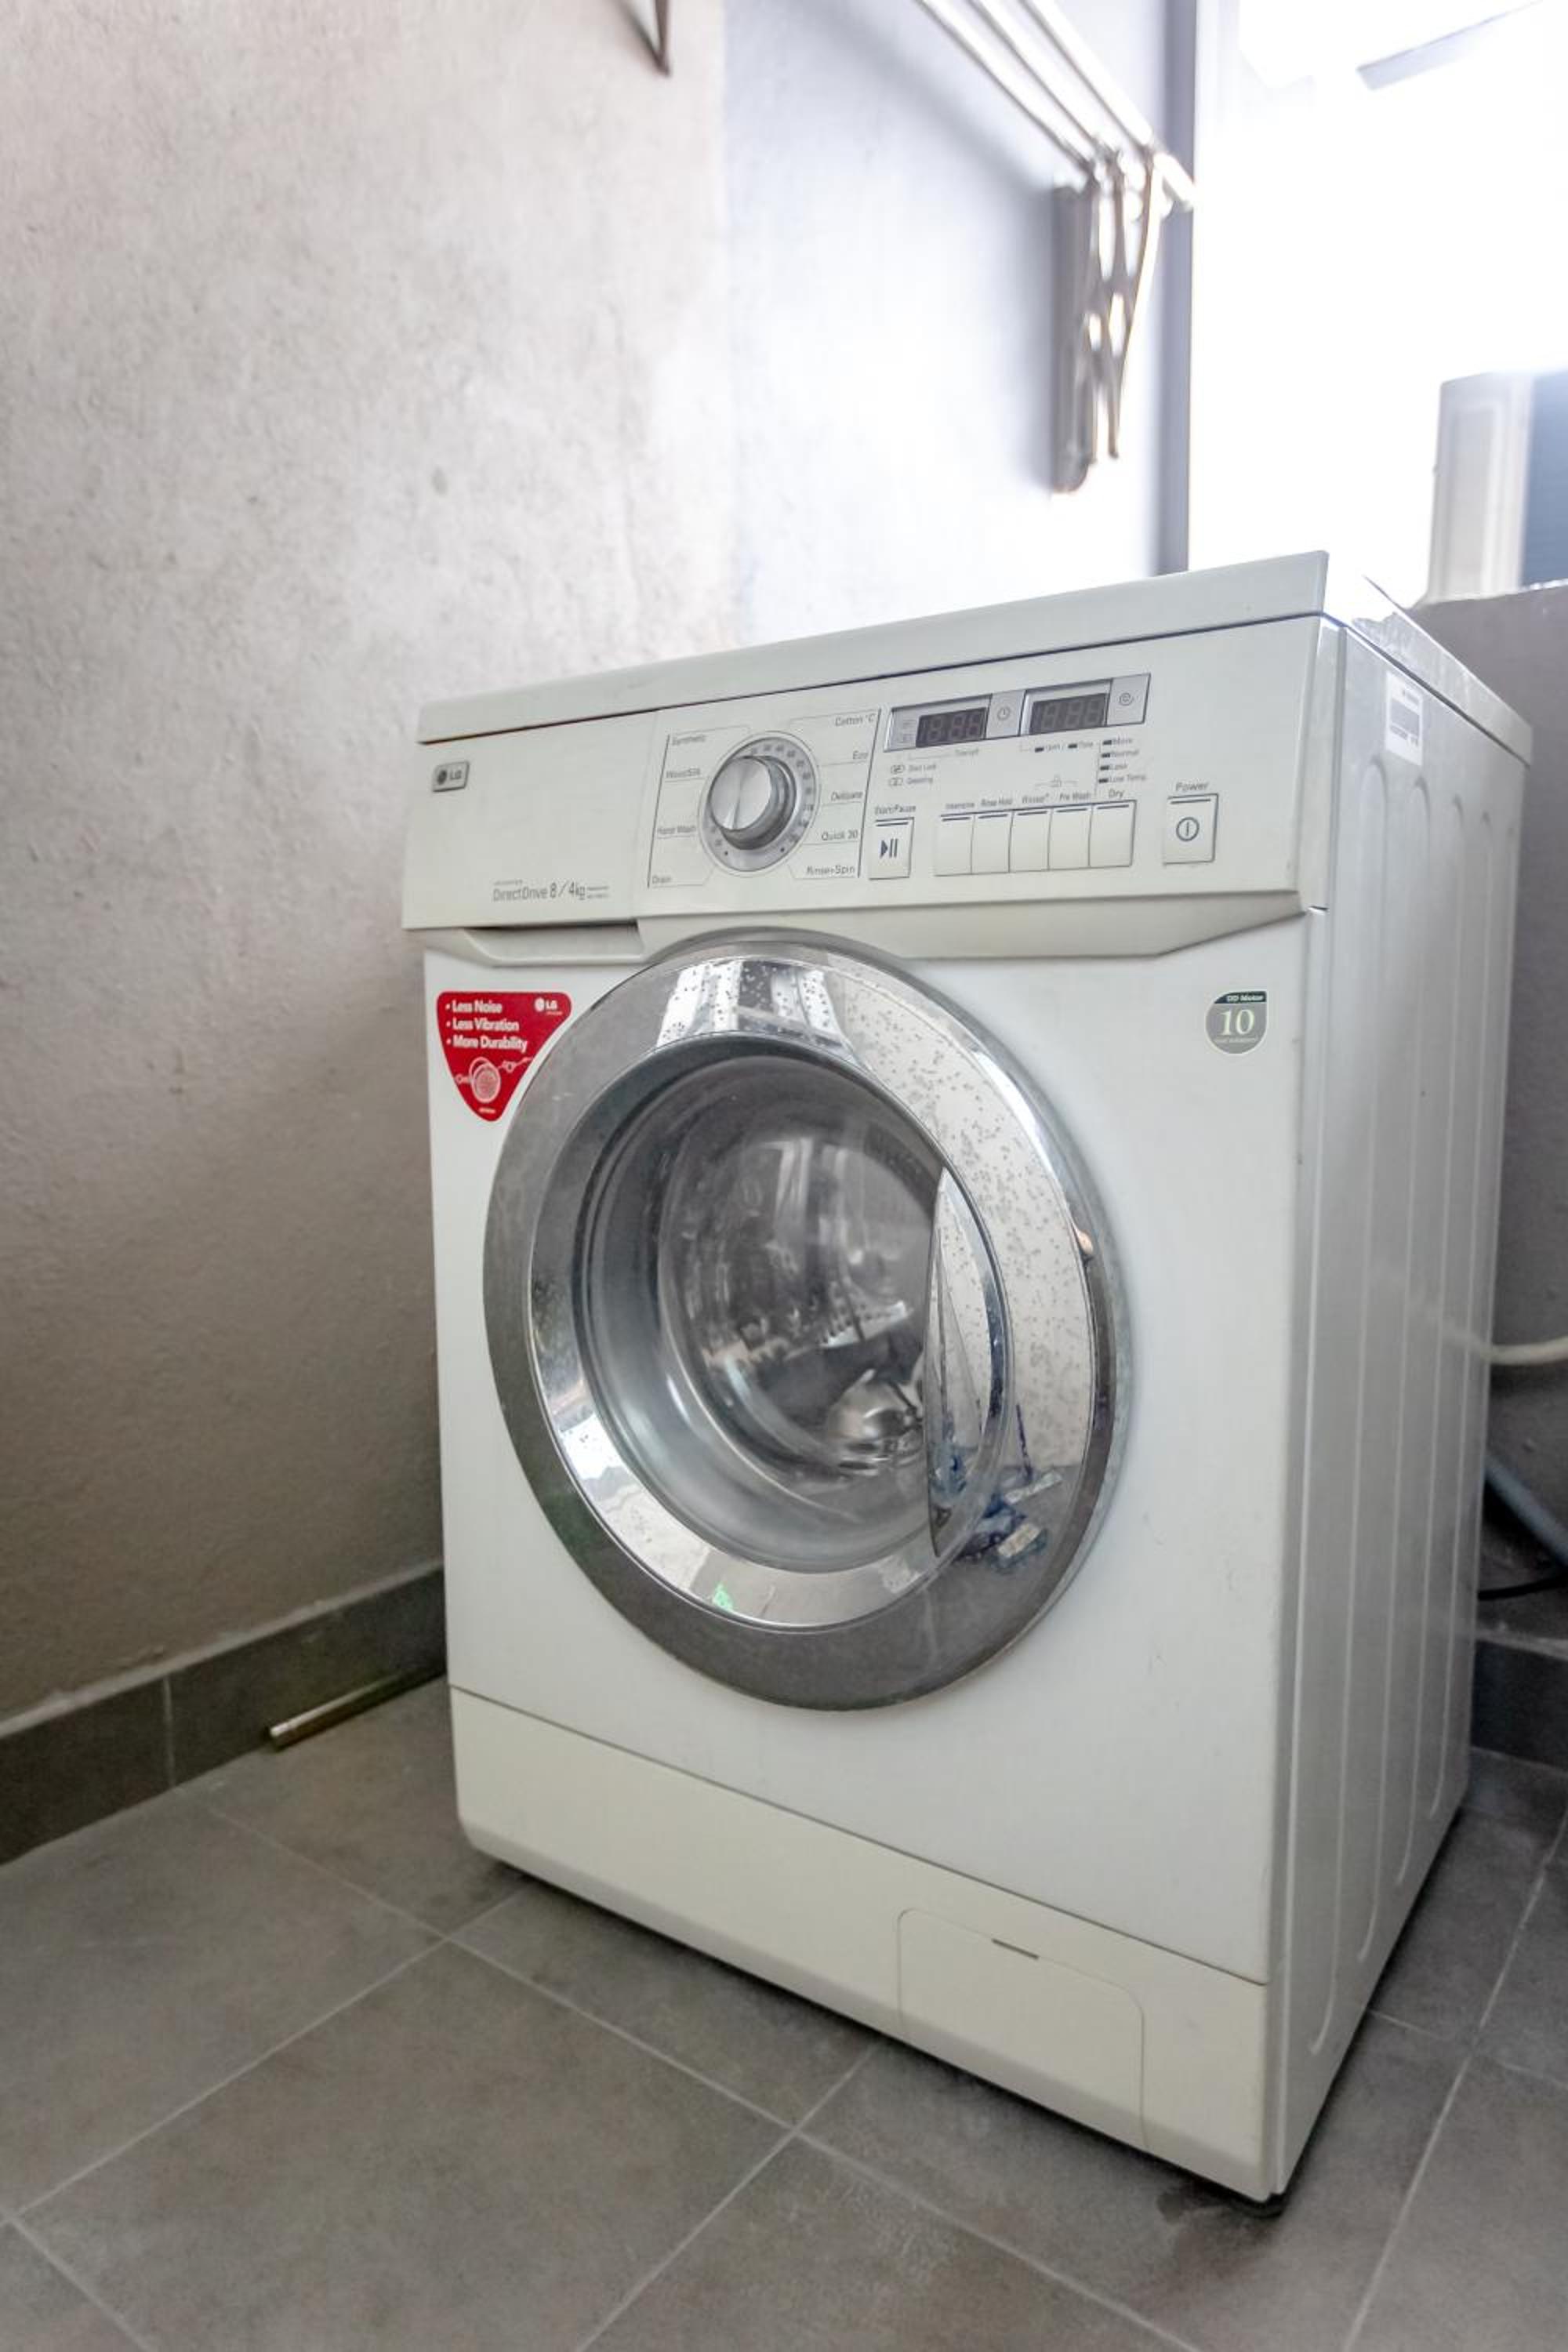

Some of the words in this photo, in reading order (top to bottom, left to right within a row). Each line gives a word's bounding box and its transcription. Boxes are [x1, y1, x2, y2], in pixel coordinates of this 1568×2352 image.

[835, 717, 862, 727] Cotton
[449, 769, 463, 781] LG
[1175, 781, 1210, 792] Power
[1107, 789, 1124, 800] Dry
[821, 830, 845, 841] Quick
[452, 1000, 473, 1013] Less
[474, 1000, 503, 1014] Noise
[546, 1000, 557, 1010] LG
[452, 1017, 474, 1030] Less
[474, 1017, 520, 1032] Vibration
[1221, 1009, 1255, 1036] 10
[452, 1034, 479, 1048] More
[479, 1034, 528, 1054] Durability
